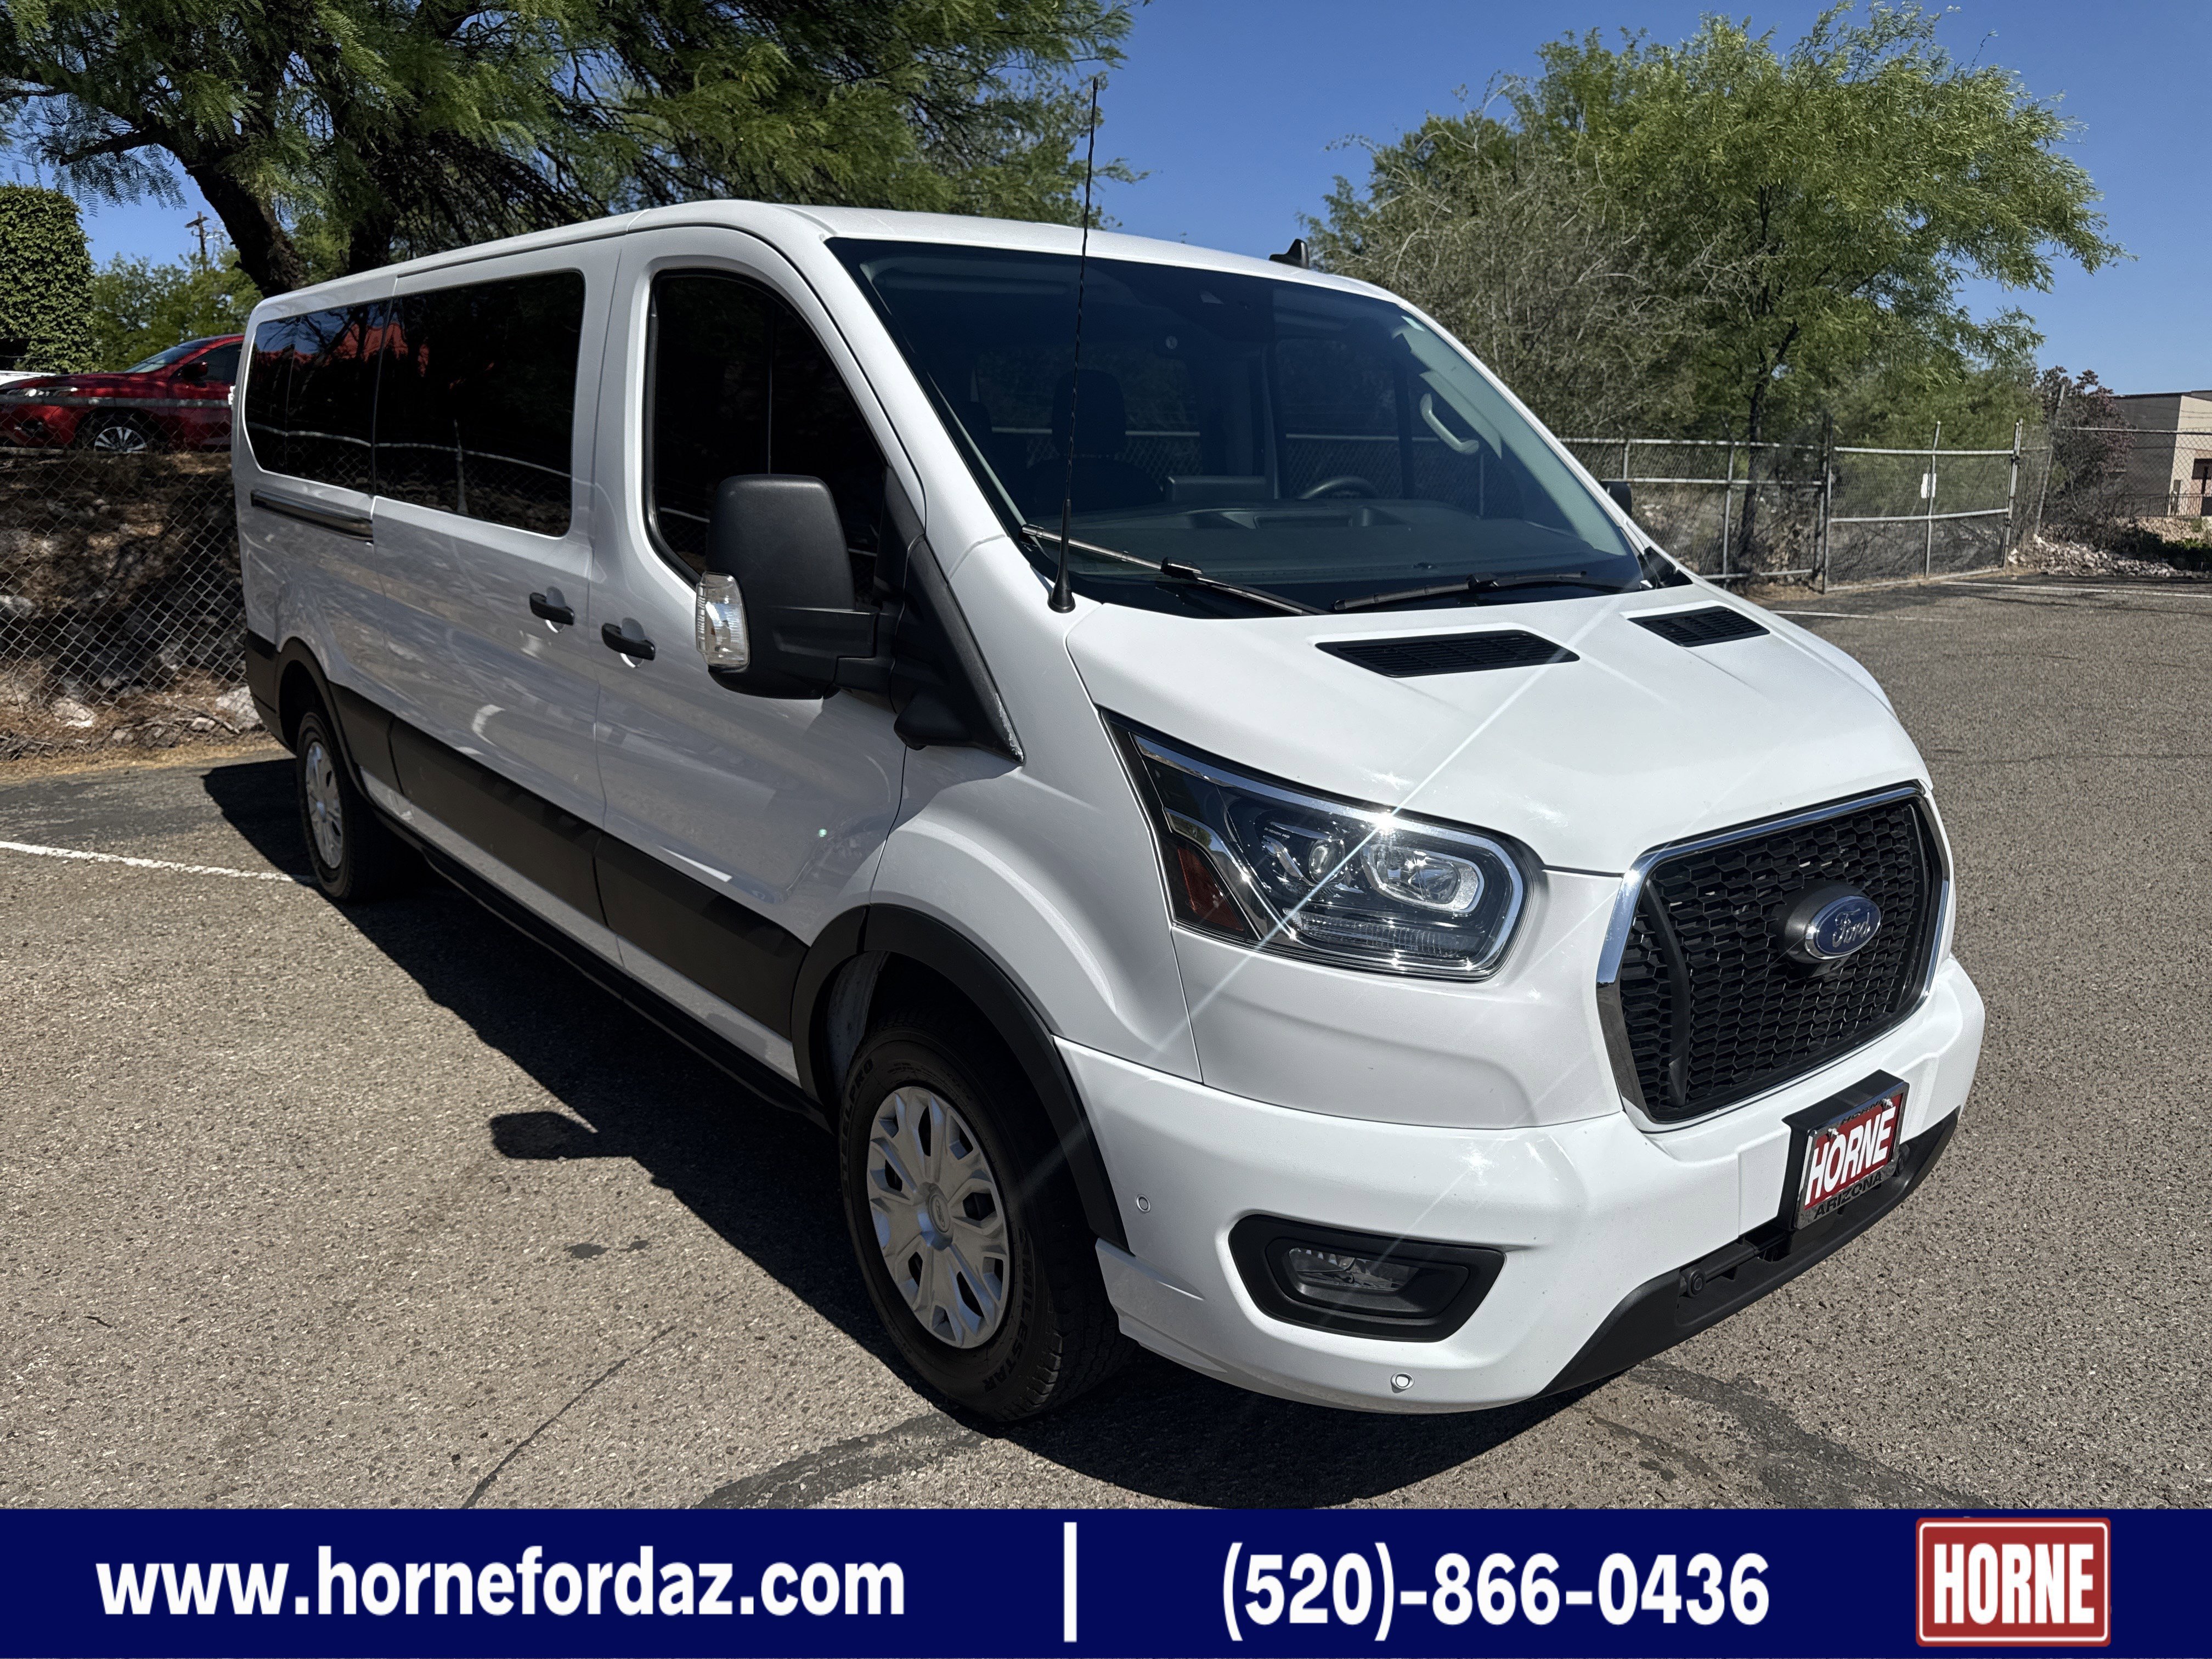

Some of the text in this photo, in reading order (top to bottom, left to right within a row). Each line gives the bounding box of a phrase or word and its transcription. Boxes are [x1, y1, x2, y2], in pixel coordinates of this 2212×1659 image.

[1832, 907, 1871, 948] Ford
[1804, 1106, 1896, 1206] HORNE
[1813, 1170, 1883, 1220] ARIZONA
